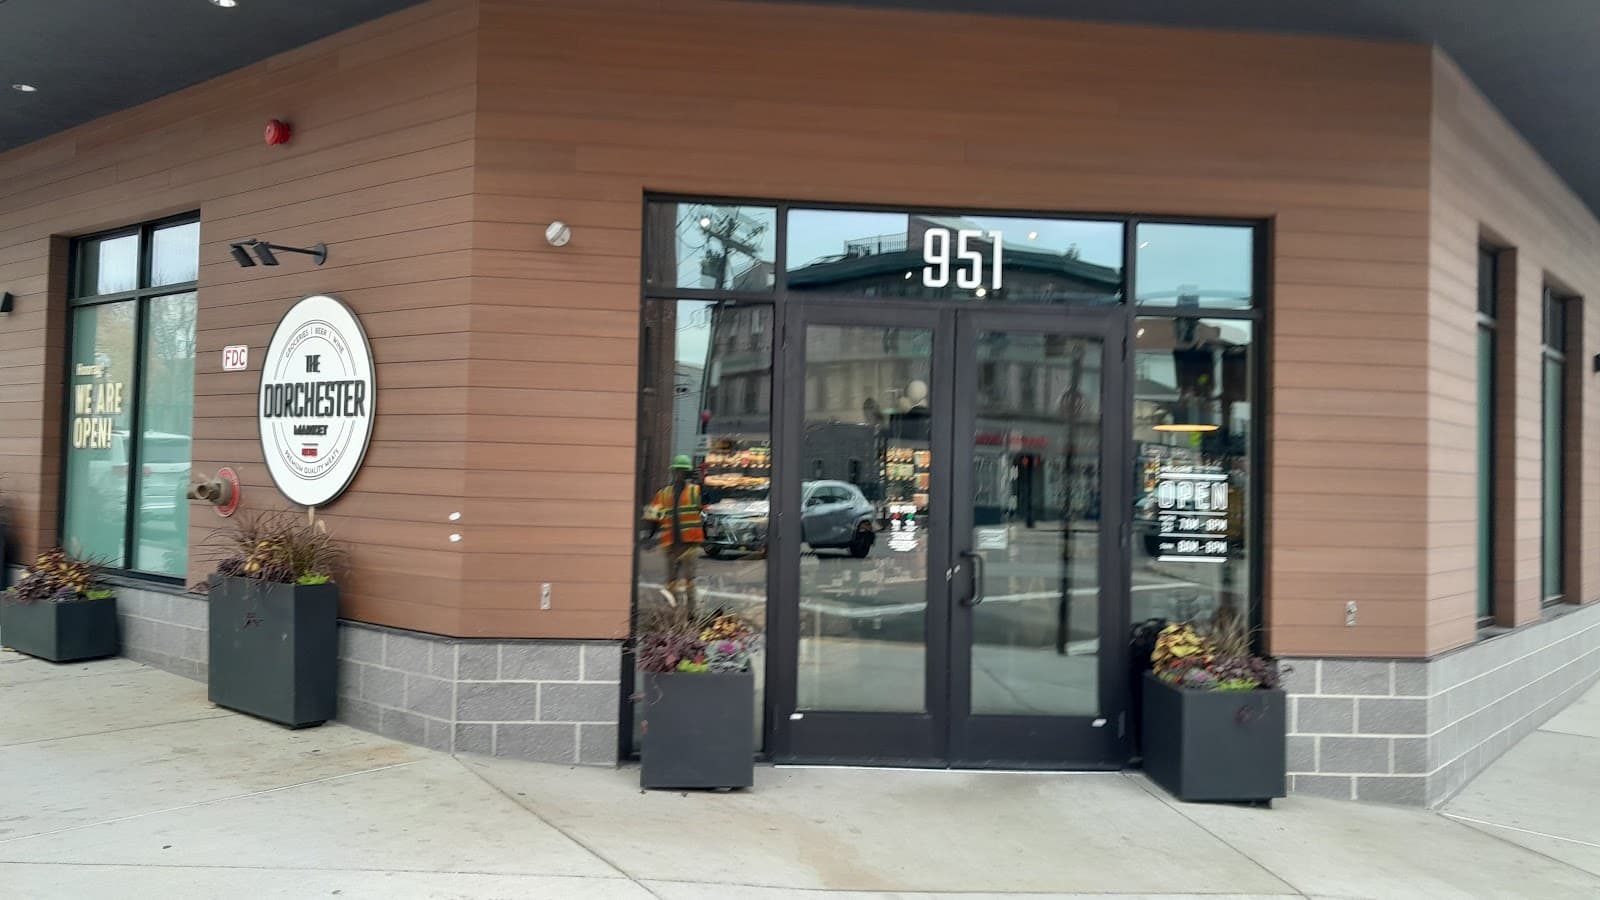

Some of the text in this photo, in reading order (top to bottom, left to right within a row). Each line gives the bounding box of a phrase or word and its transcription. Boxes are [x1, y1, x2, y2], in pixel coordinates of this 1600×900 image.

[922, 227, 1003, 290] 951
[225, 348, 246, 367] FDC
[285, 327, 345, 358] GROCERIES BEER WINE
[305, 354, 321, 373] THE
[75, 382, 123, 415] WE ARE
[263, 380, 366, 419] DORCHESTER
[73, 417, 112, 449] OPEN!
[284, 449, 304, 472] PREMIUM
[303, 464, 325, 475] QUALITY
[324, 448, 340, 467] MEATS
[1158, 480, 1229, 510] OPEN
